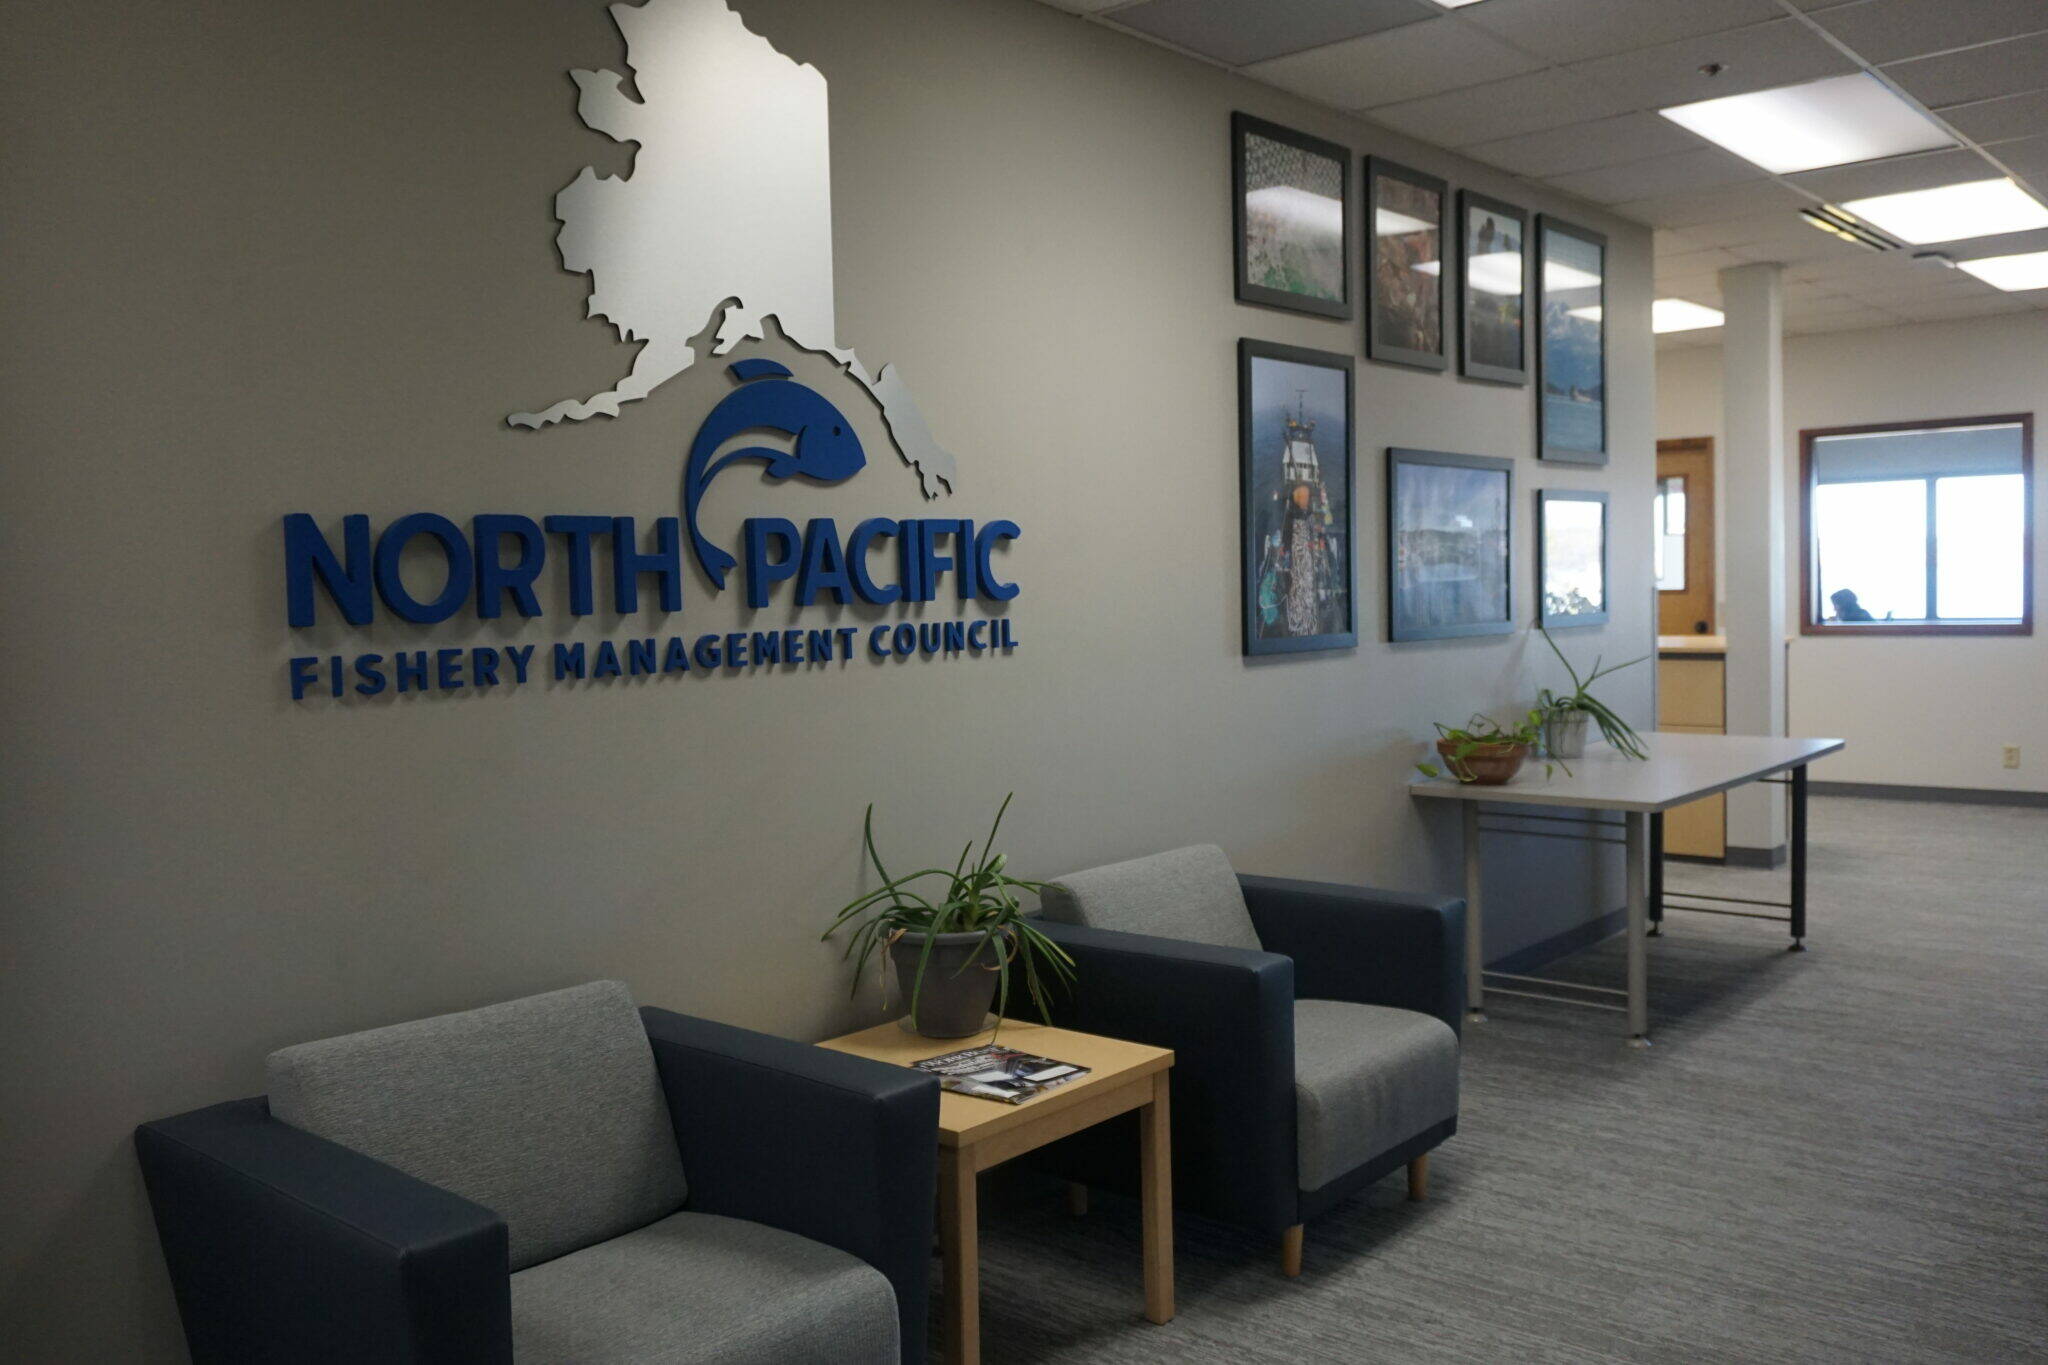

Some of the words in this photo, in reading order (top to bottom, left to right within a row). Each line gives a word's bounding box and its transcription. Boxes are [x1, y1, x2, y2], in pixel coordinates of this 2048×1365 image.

[283, 512, 682, 628] NORTH
[744, 517, 1021, 608] PACIFIC
[290, 645, 535, 700] FISHERY
[554, 627, 857, 680] MANAGEMENT
[870, 618, 1018, 657] COUNCIL
